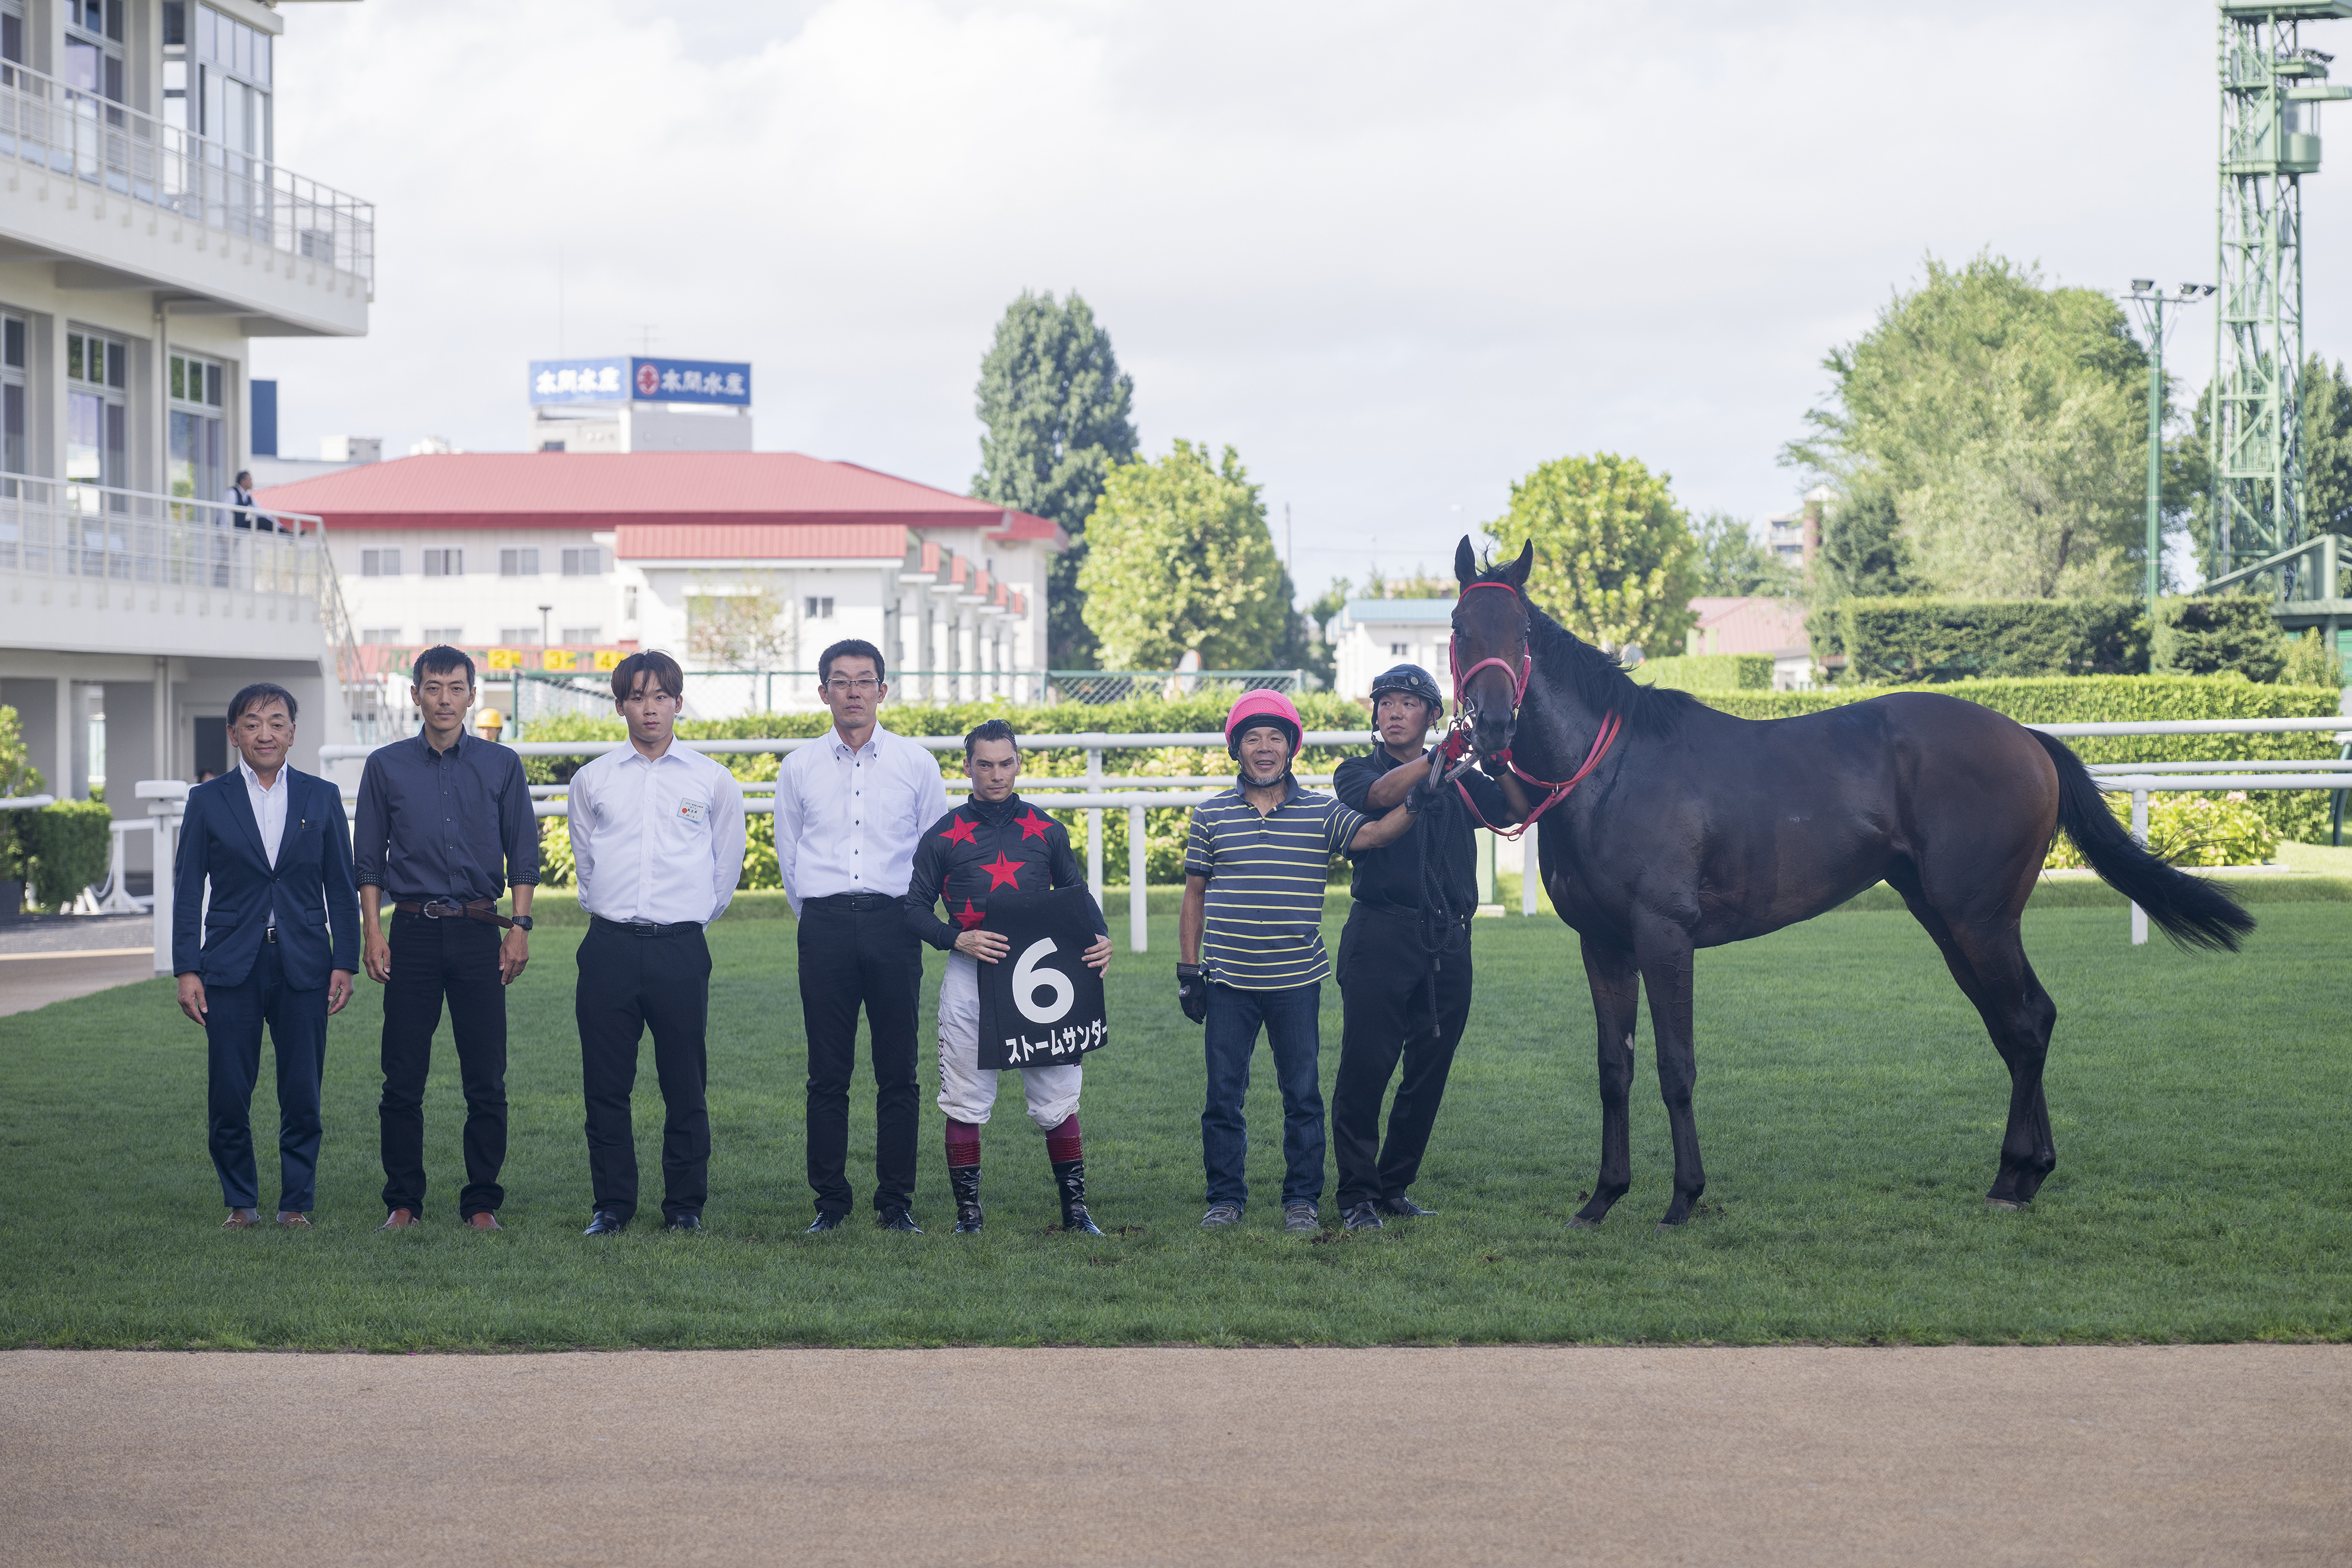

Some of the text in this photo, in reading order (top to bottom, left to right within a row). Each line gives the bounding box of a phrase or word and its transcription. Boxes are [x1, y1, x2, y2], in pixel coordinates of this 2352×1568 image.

[493, 651, 505, 668] 2
[549, 651, 561, 668] 3
[600, 652, 611, 668] 4
[1012, 937, 1074, 1024] 6
